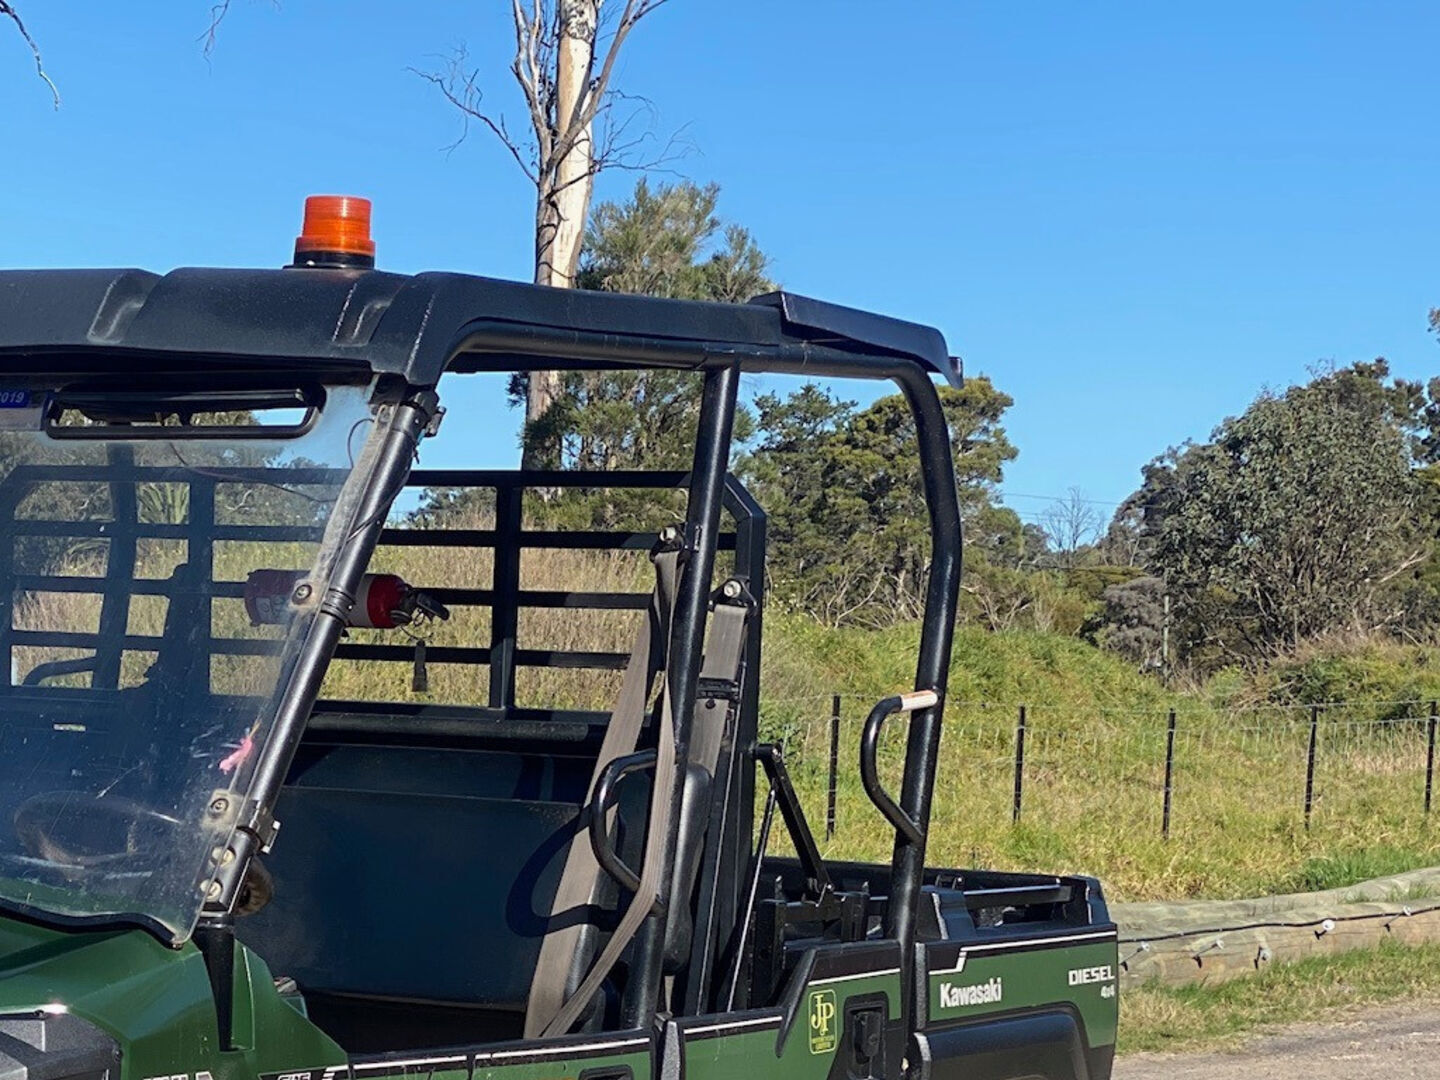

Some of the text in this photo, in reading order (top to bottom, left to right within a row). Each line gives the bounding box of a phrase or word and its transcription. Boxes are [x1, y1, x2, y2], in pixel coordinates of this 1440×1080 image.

[1068, 965, 1115, 986] DIESEL
[940, 977, 1002, 1008] Kawasaki
[811, 994, 834, 1036] JP
